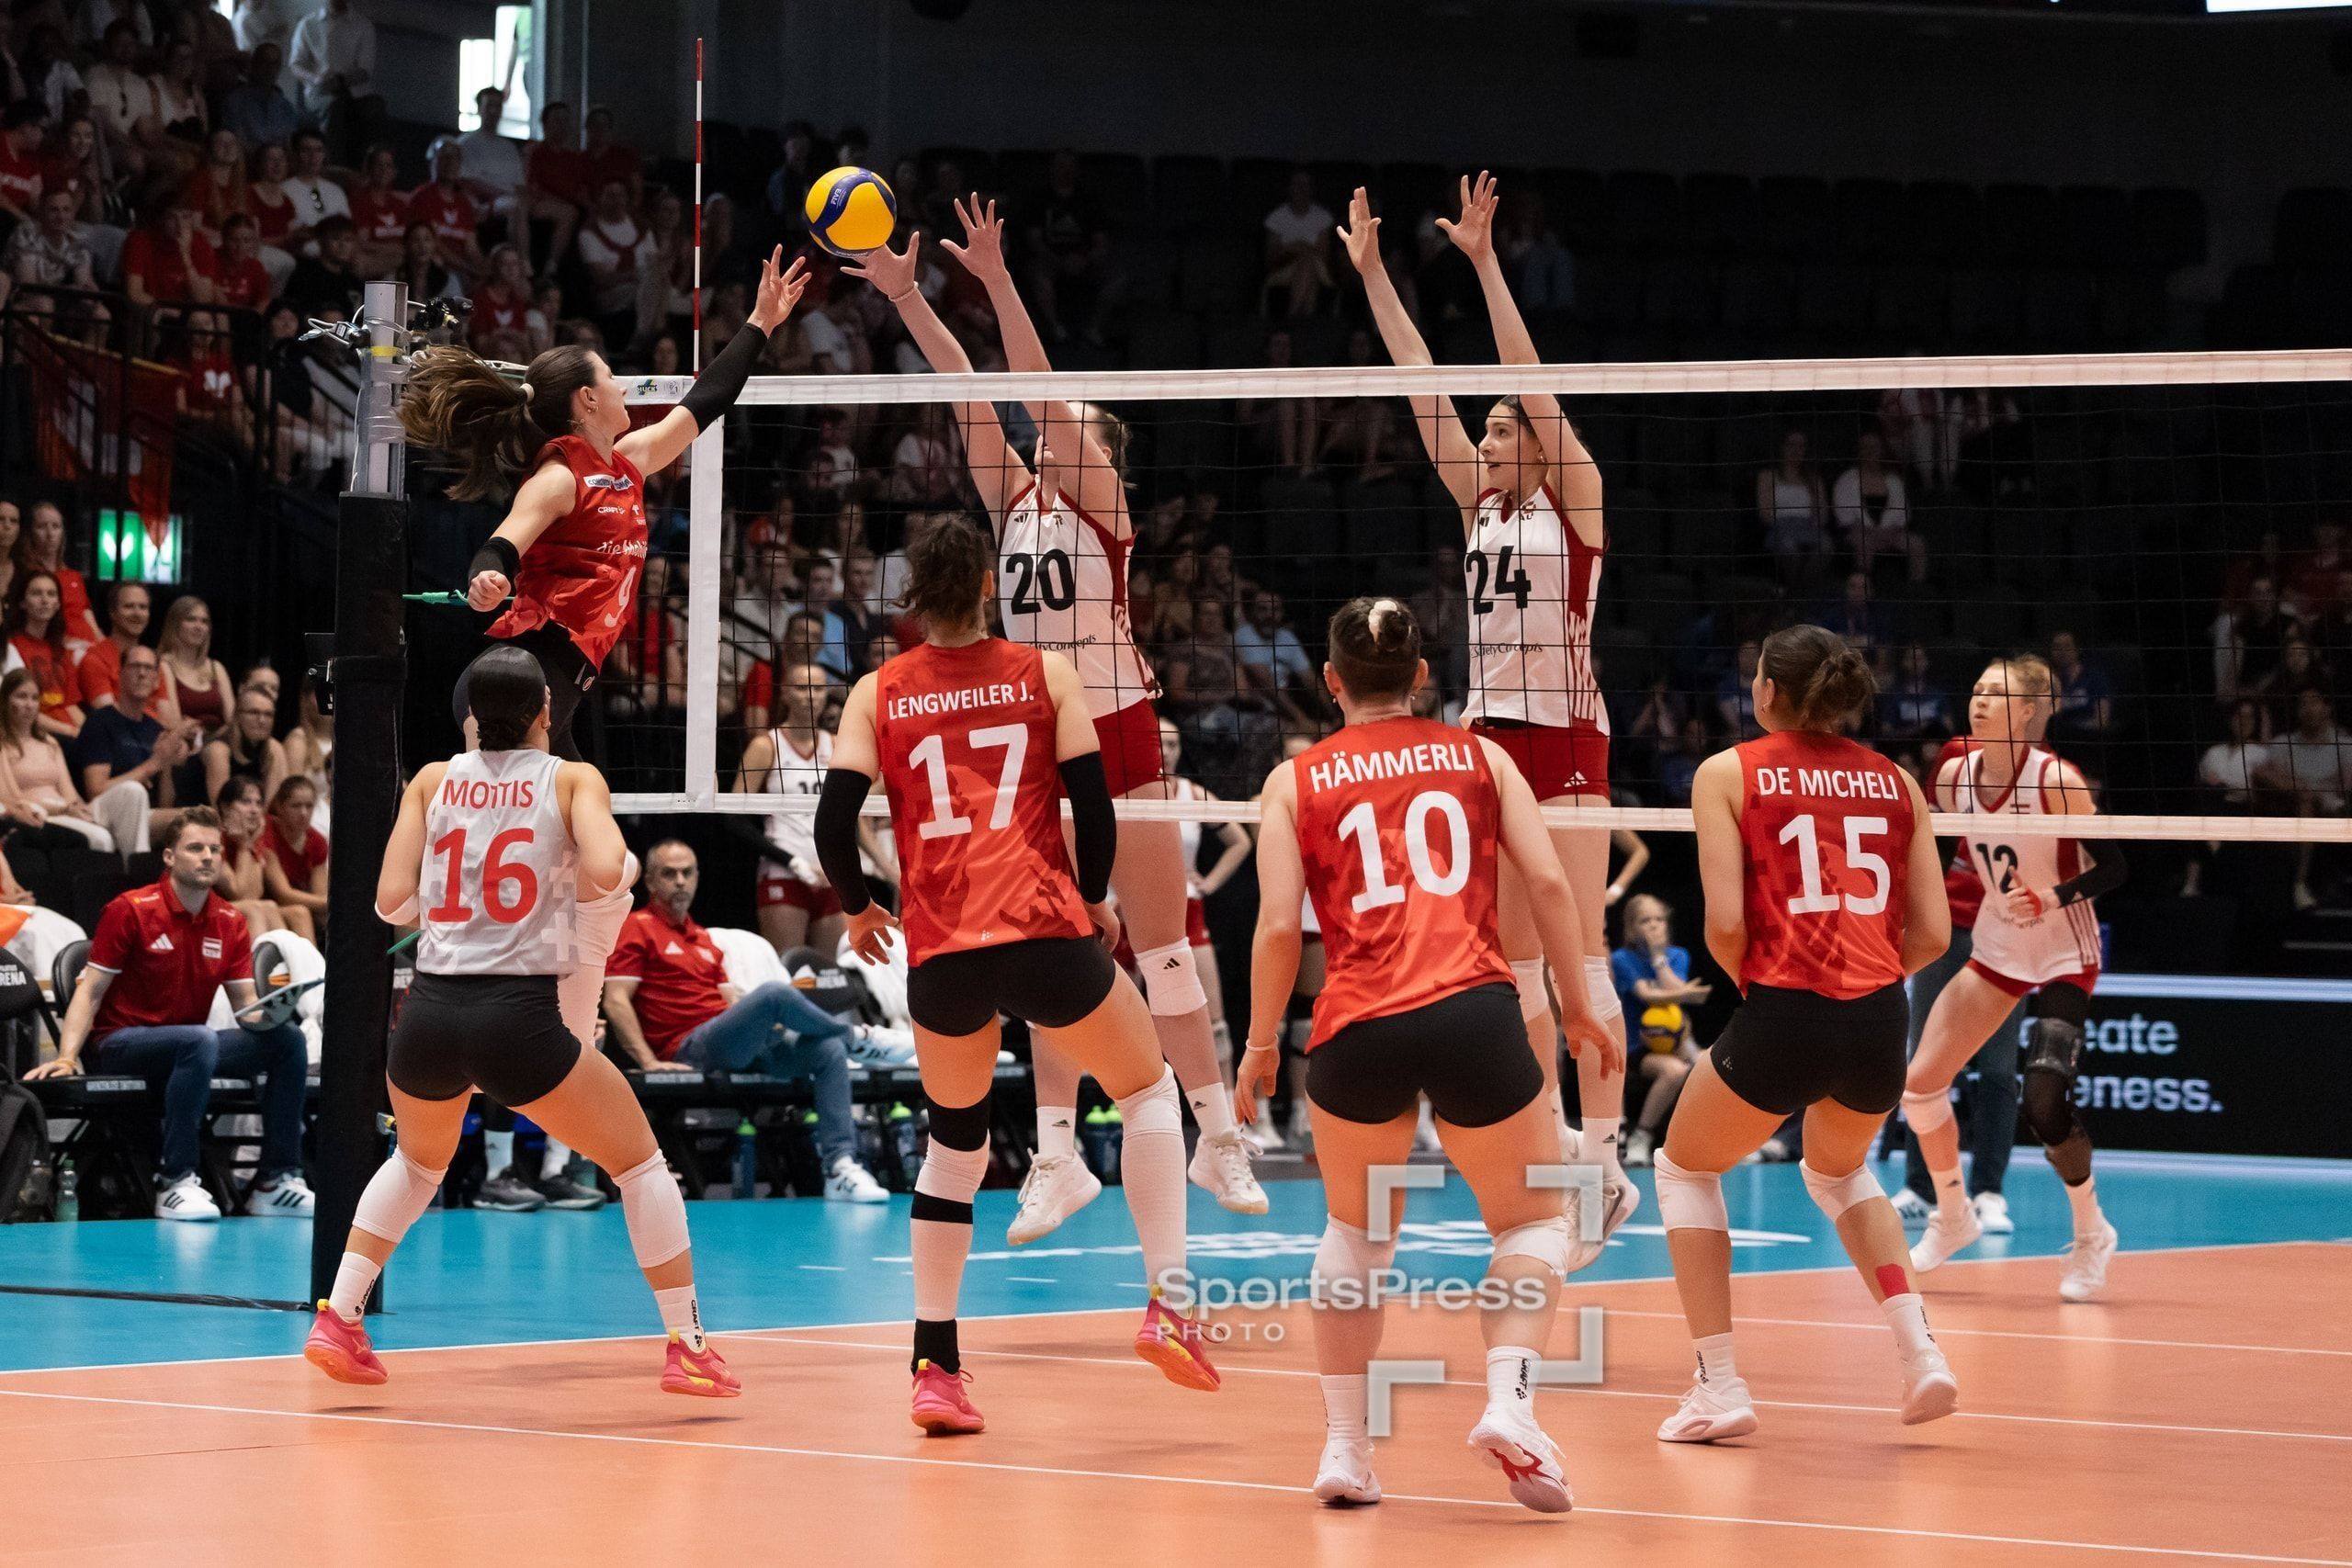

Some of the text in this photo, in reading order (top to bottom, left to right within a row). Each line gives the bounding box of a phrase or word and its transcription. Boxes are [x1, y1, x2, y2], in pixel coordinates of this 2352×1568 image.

[1006, 548, 1076, 615] 20
[1464, 545, 1532, 615] 24
[888, 681, 1035, 721] LENGWEILER J.
[442, 779, 534, 809] MOTTIS
[908, 722, 1029, 841] 17
[1310, 743, 1475, 794] HÄMMERLI
[1757, 767, 1900, 801] DE MICHELI
[428, 828, 538, 924] 16
[1337, 790, 1471, 914] 10
[1779, 814, 1891, 916] 15
[1974, 842, 2018, 895] 12
